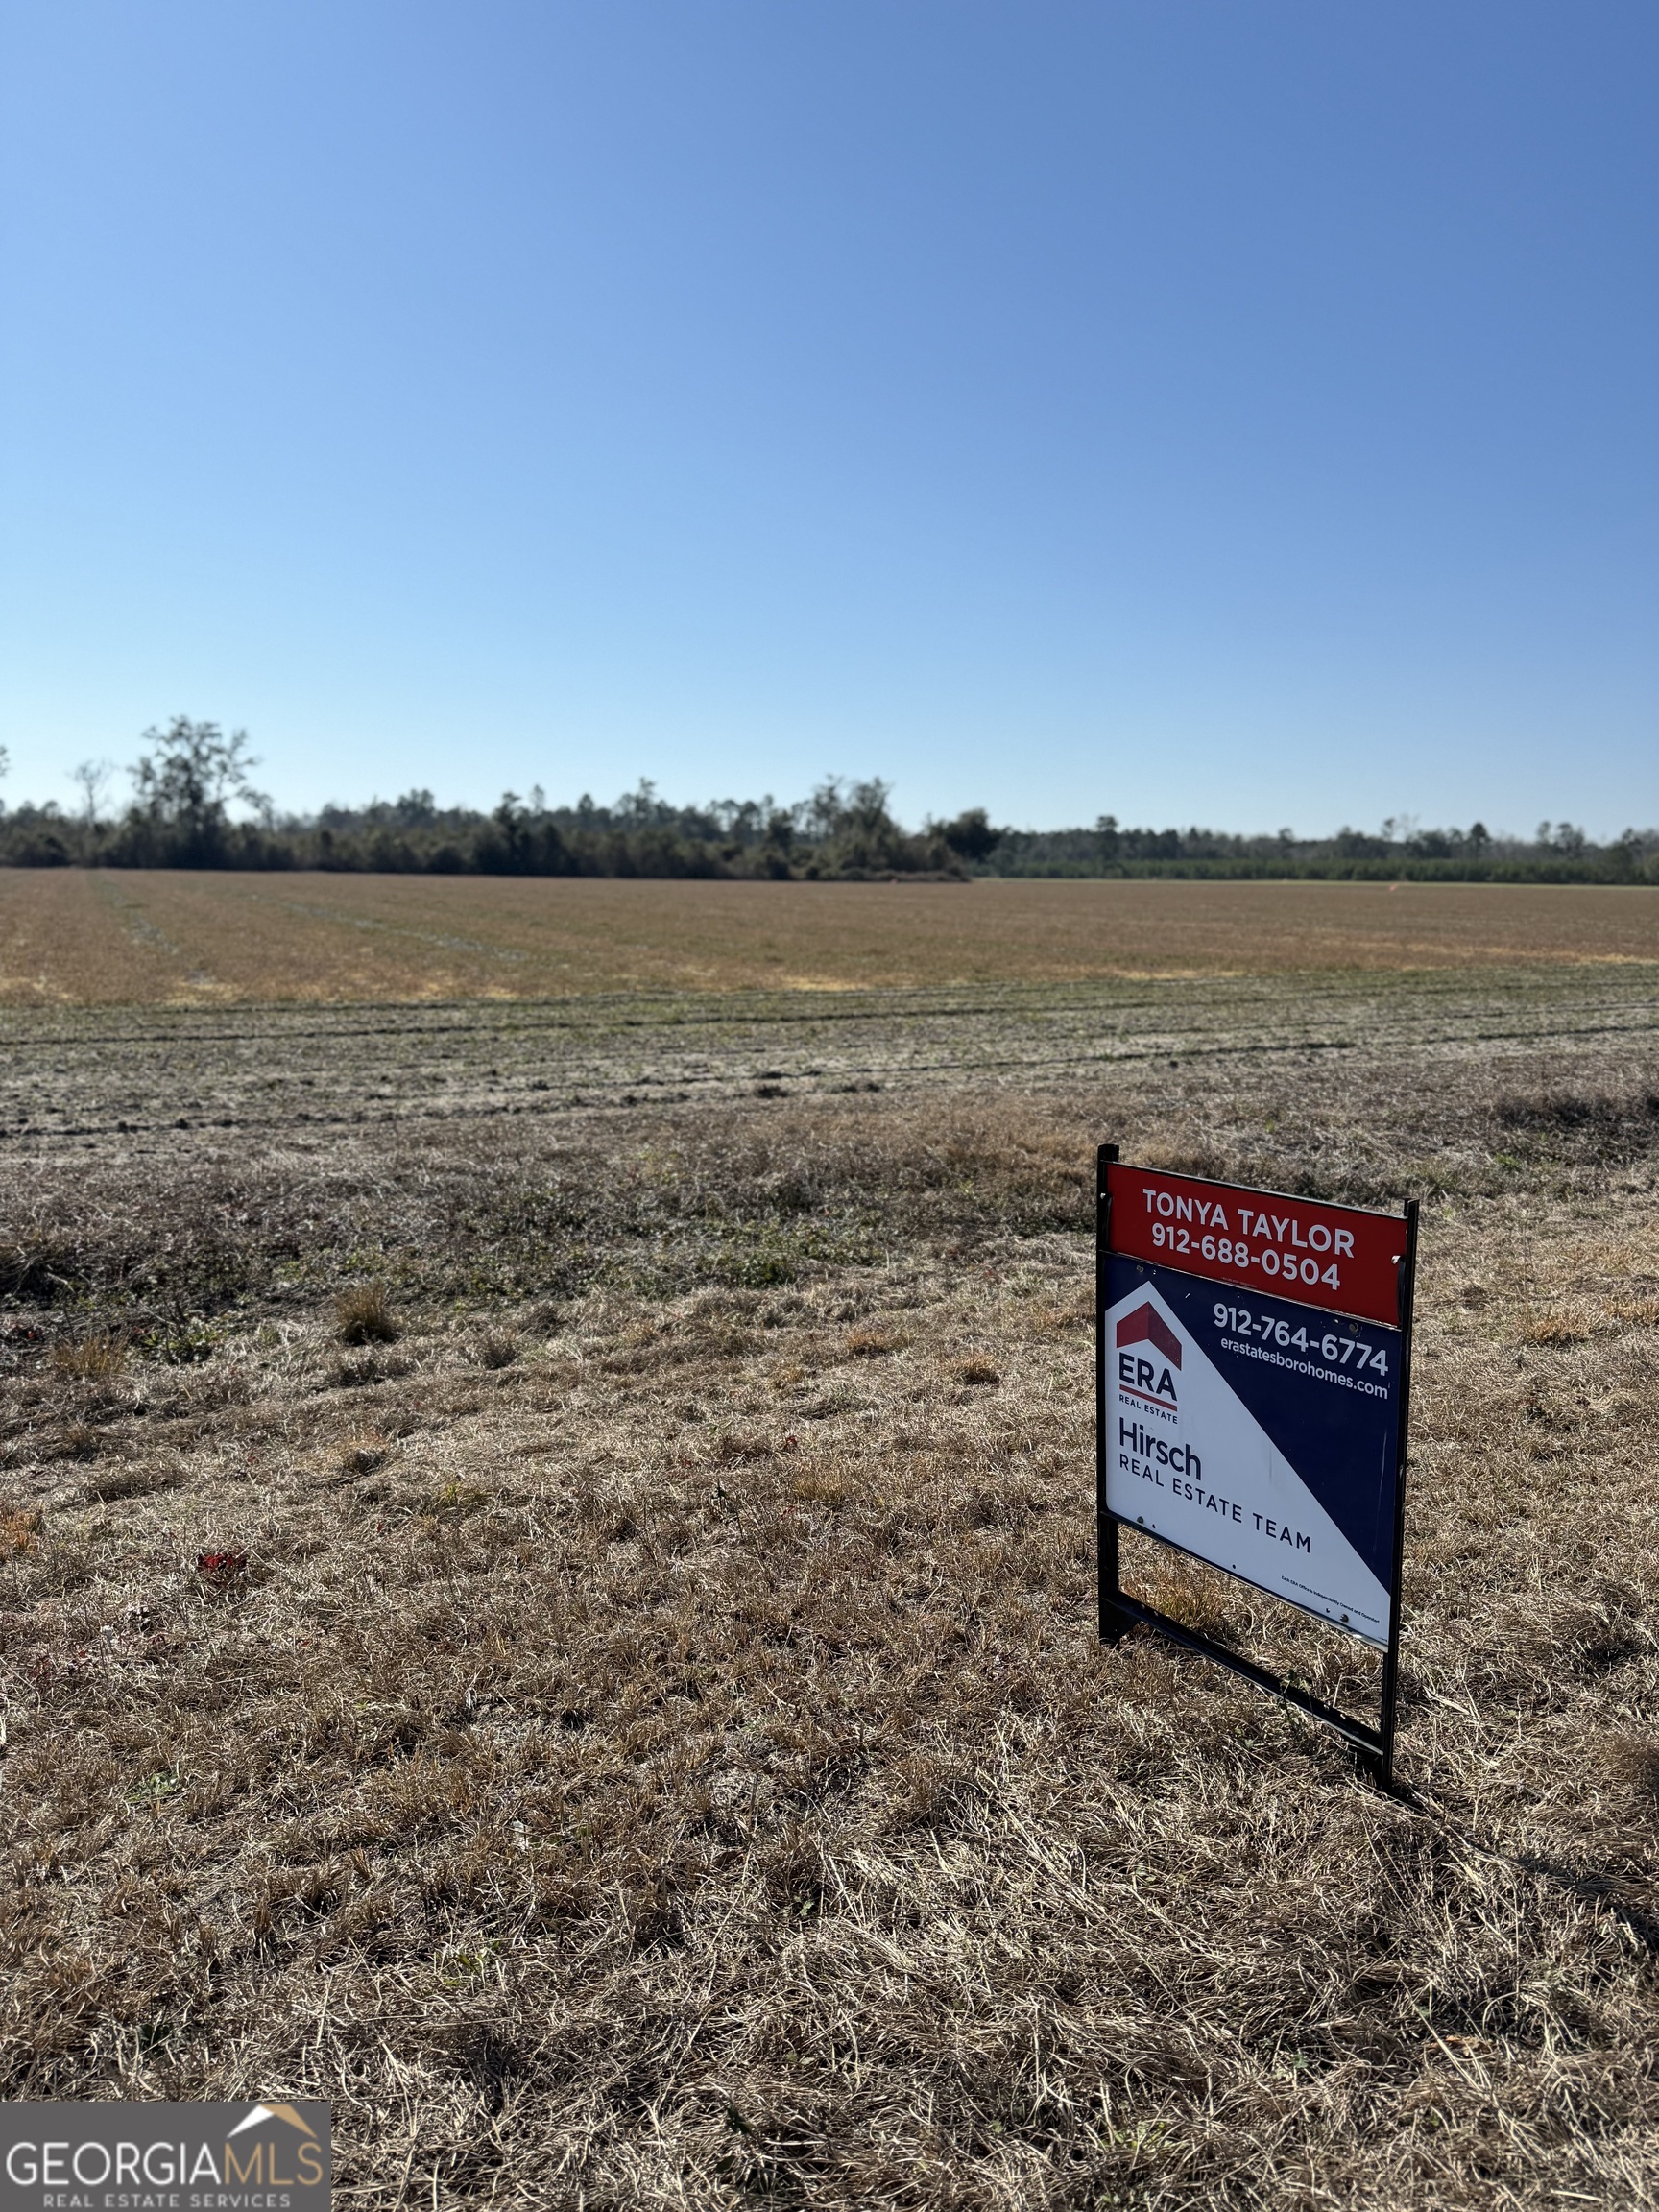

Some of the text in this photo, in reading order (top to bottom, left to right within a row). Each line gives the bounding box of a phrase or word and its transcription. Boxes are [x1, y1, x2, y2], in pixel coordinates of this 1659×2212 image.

[1142, 1188, 1355, 1258] TONYA TAYLOR
[1152, 1222, 1340, 1290] 912-688-0504
[1214, 1303, 1388, 1377] 912-764-6774
[1220, 1337, 1388, 1400] erastatesborohomes.com
[1118, 1352, 1178, 1402] ERA
[1118, 1394, 1178, 1425] REAL ESTATE
[1118, 1416, 1202, 1481] Hirsch
[1119, 1453, 1310, 1553] REAL ESTATE TEAM
